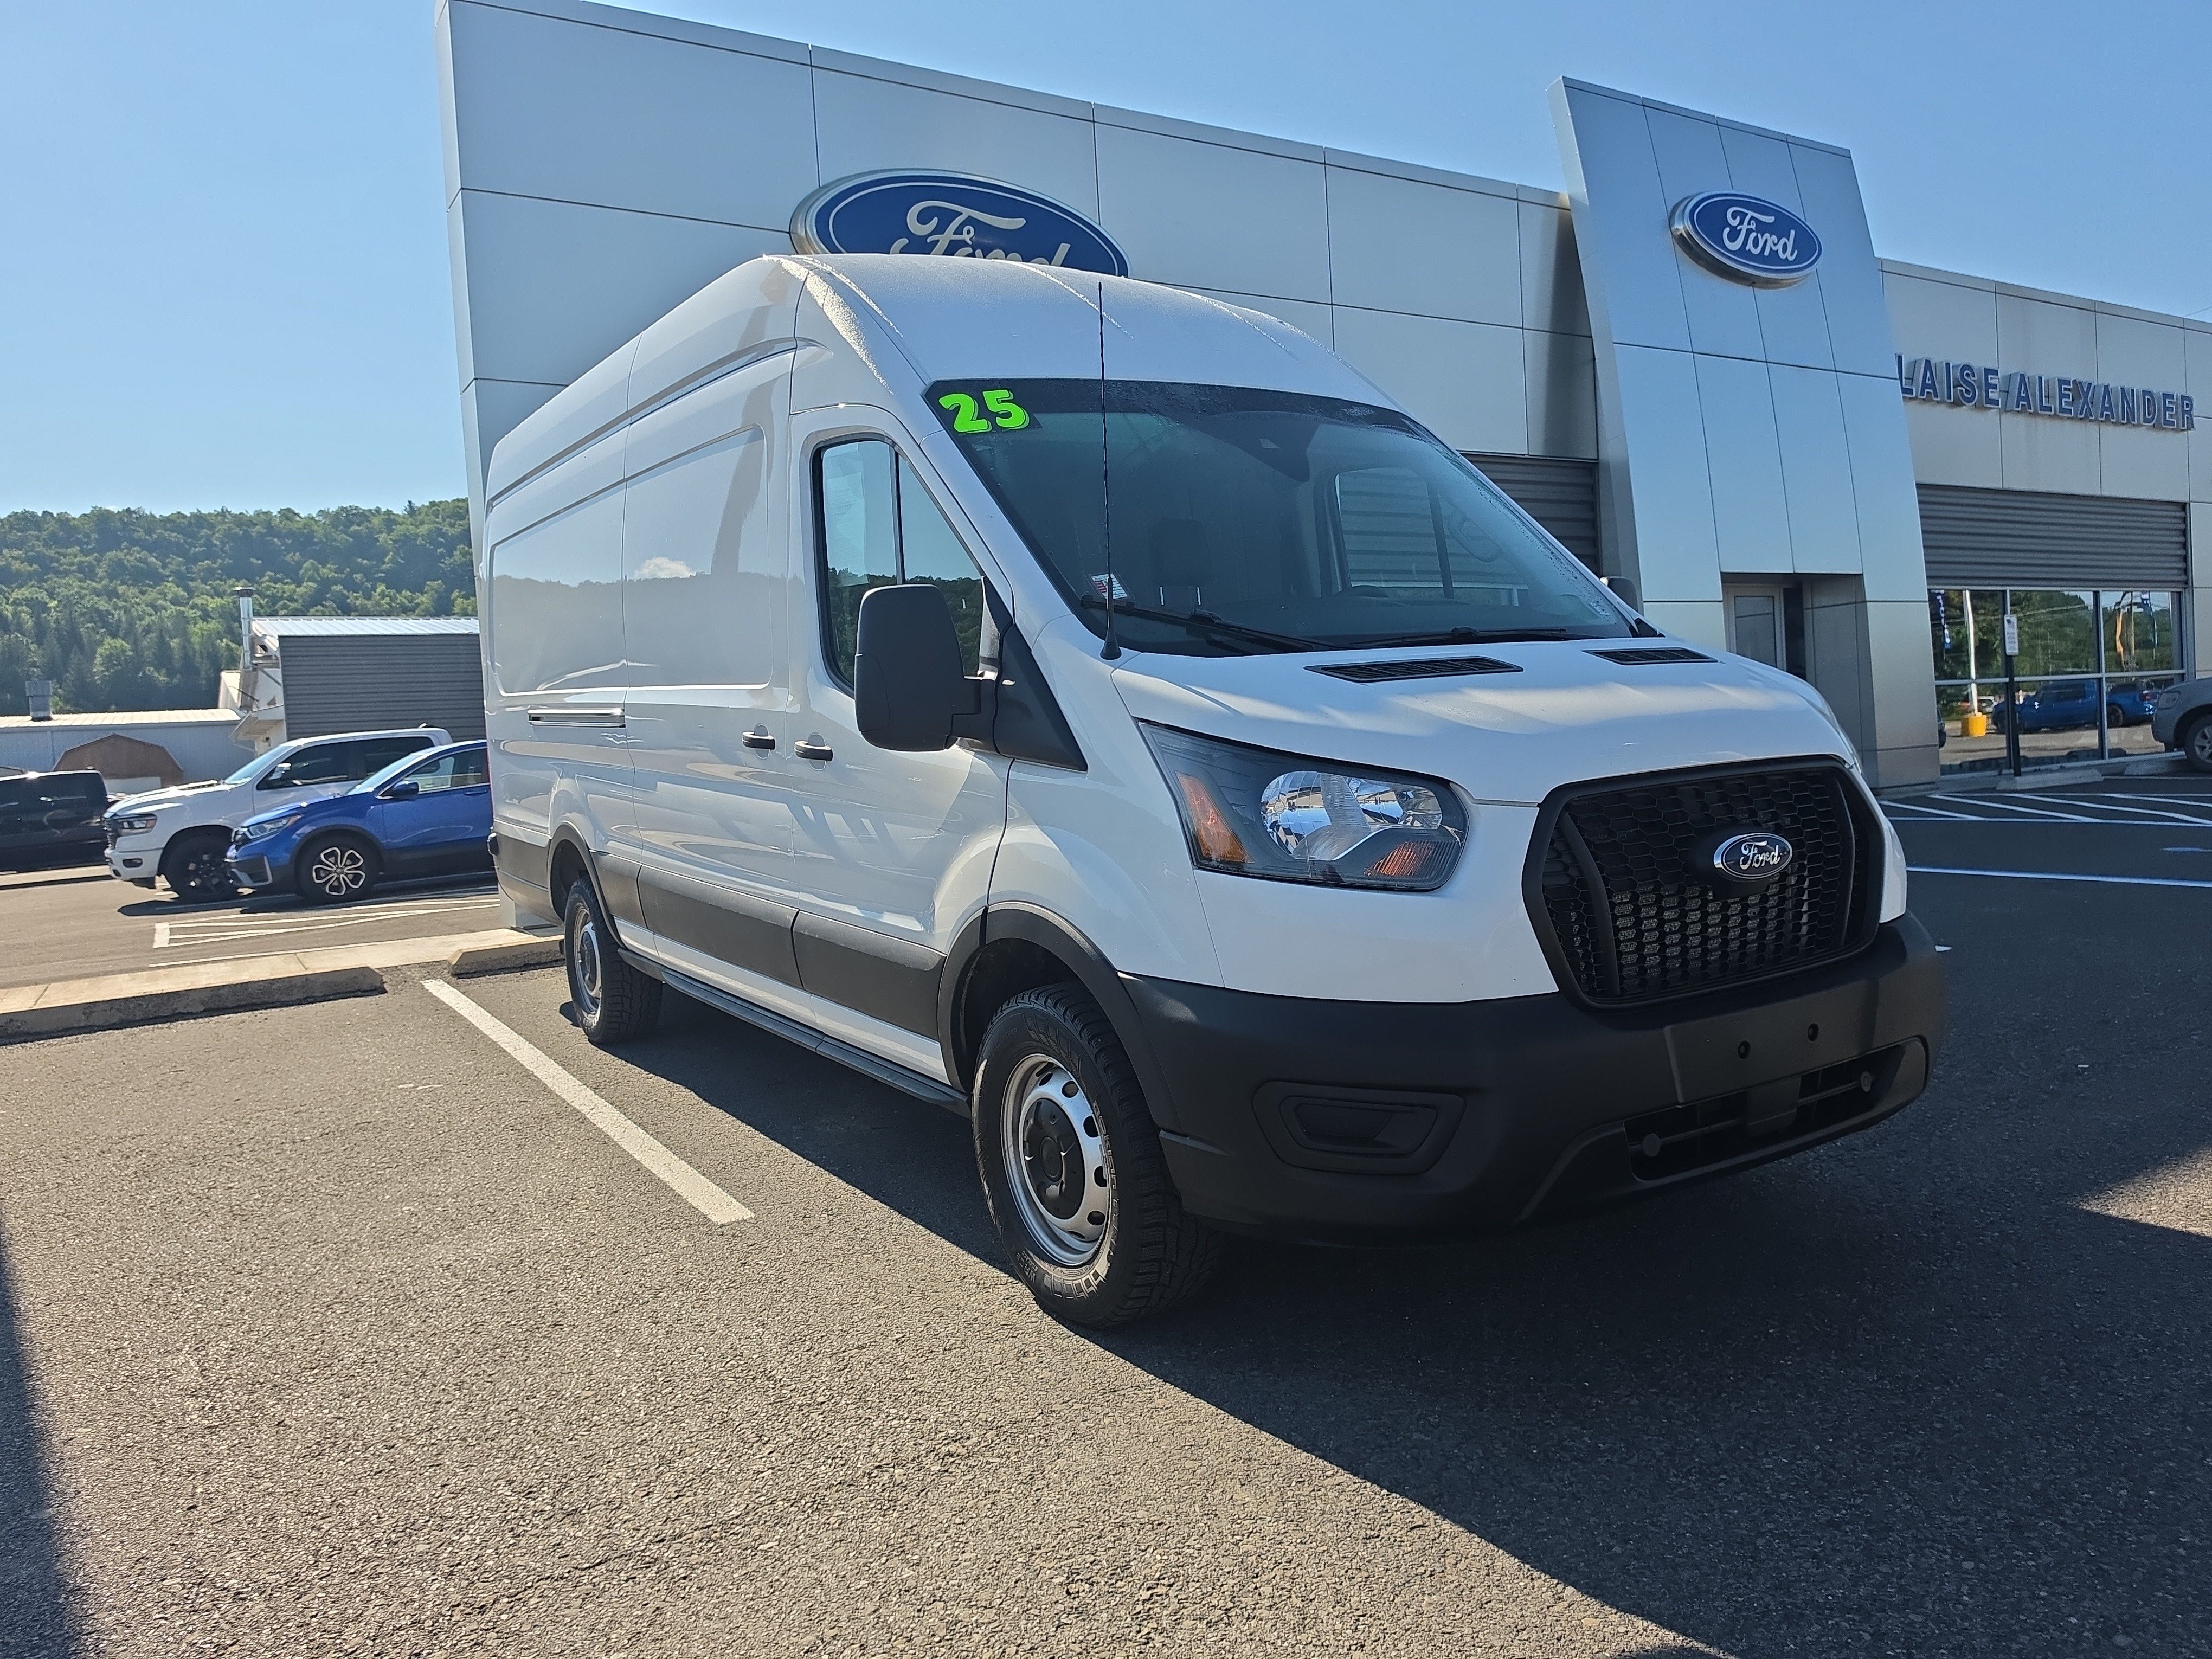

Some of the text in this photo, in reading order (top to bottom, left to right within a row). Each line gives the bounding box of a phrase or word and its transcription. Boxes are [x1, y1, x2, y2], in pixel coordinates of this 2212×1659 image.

[1722, 207, 1797, 261] Ford
[938, 389, 1030, 434] 25
[2014, 371, 2195, 431] ALEXANDER
[1740, 840, 1780, 870] Ford
